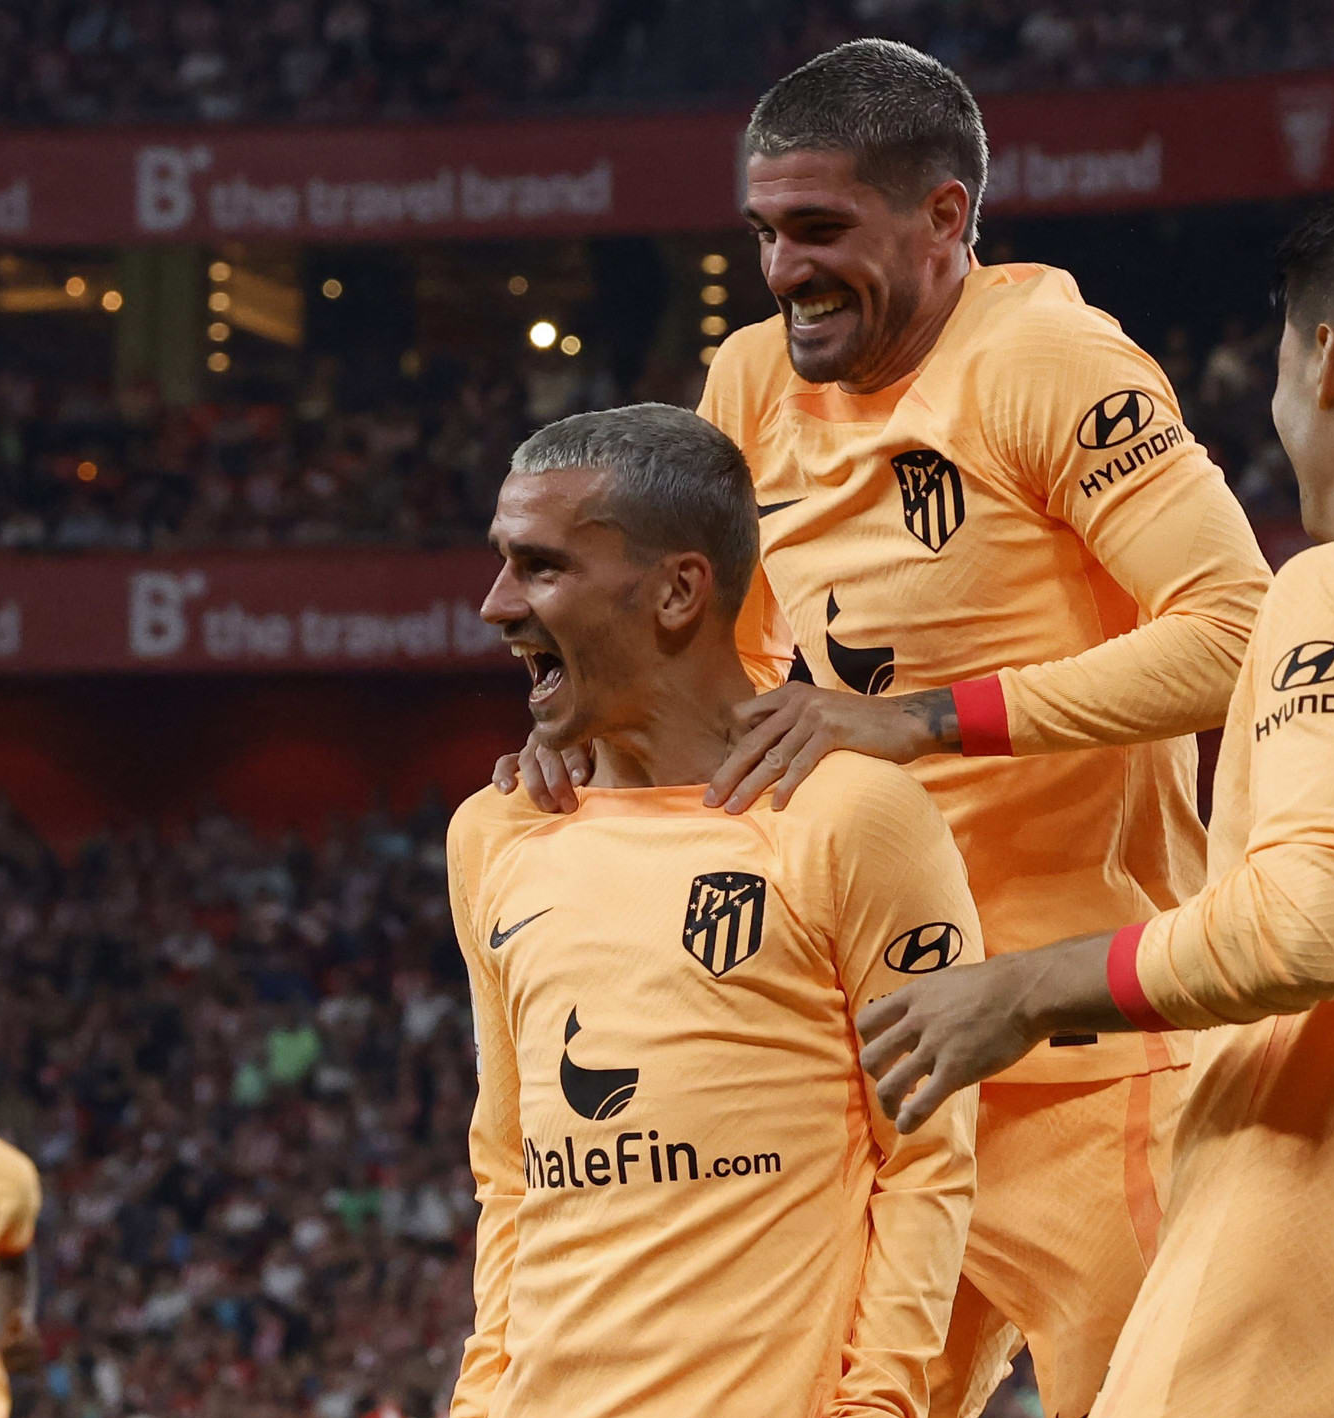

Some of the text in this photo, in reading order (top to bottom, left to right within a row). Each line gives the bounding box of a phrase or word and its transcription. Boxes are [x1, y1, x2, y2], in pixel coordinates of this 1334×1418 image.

[208, 176, 302, 229] the
[308, 166, 454, 226] travel
[459, 158, 615, 219] brand
[1079, 424, 1184, 498] HYUNDAI
[204, 604, 292, 658] the
[299, 600, 450, 657] travel
